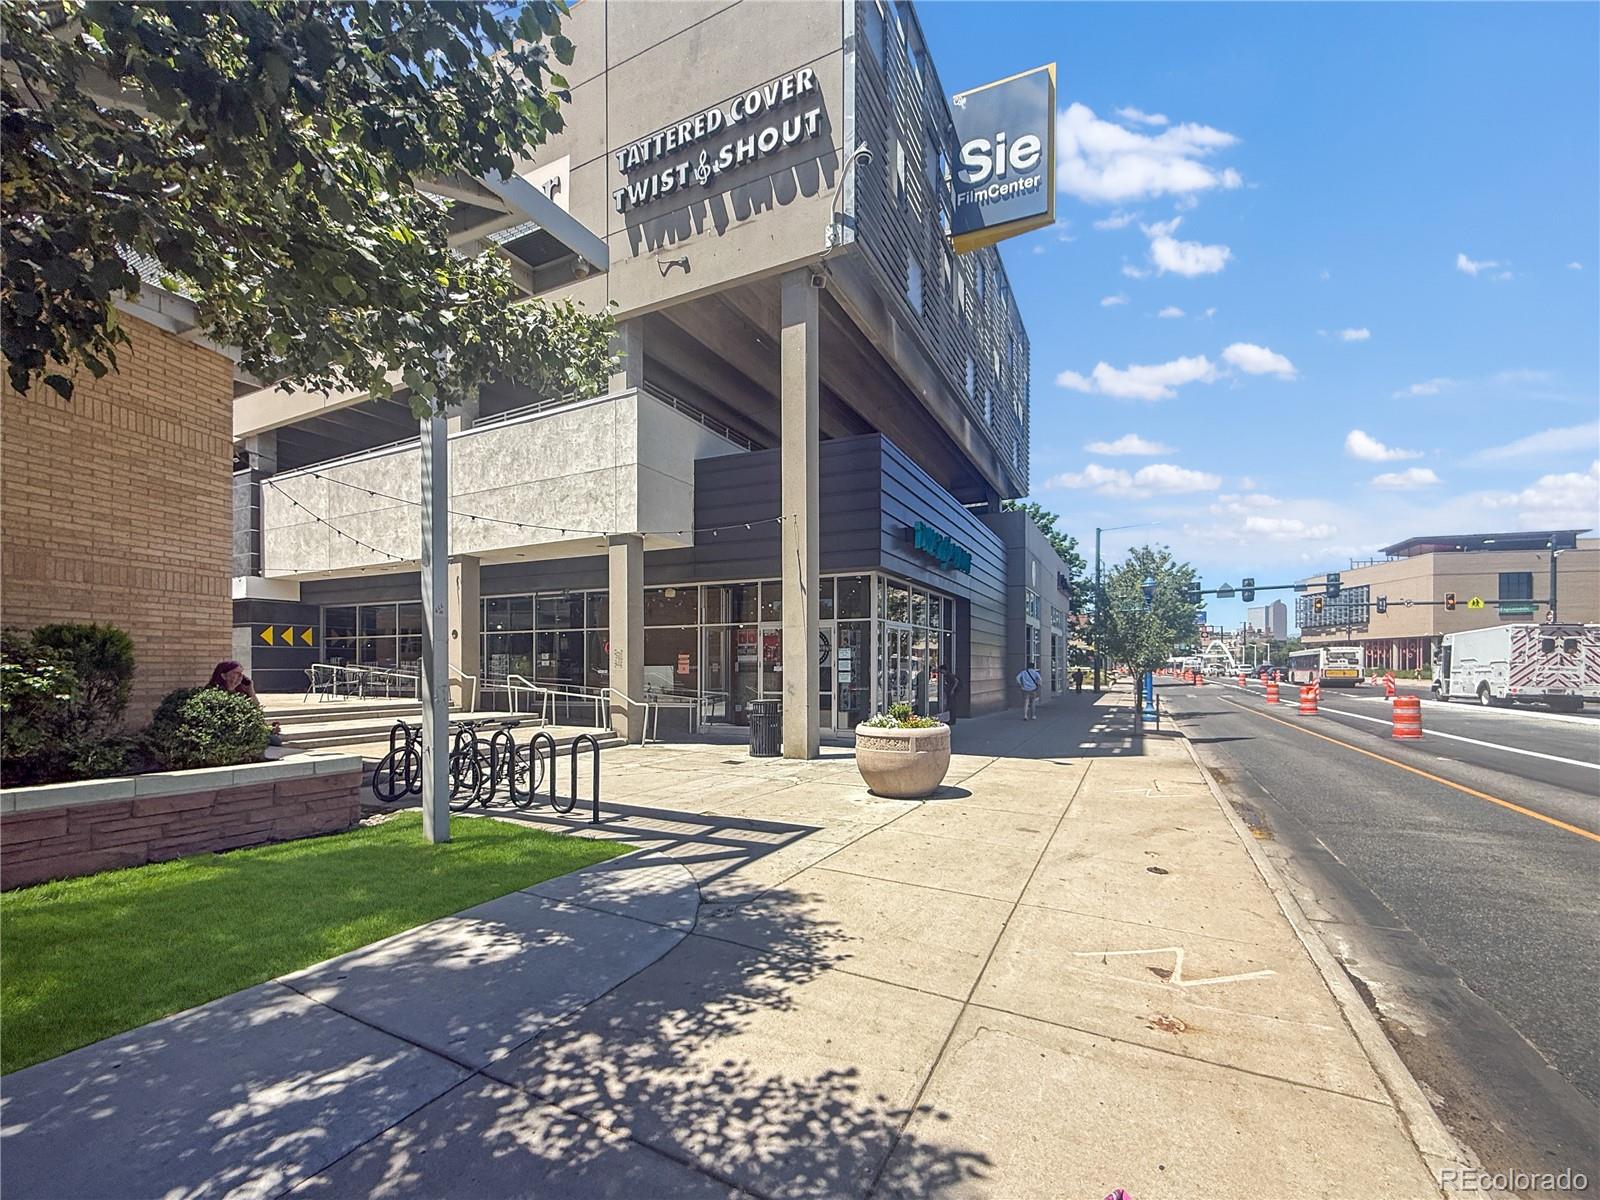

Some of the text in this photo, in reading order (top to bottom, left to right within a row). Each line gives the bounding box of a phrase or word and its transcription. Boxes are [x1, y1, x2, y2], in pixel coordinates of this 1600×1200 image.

[616, 67, 814, 172] TATTERED COVER
[957, 131, 1041, 184] Sie
[613, 161, 690, 212] TWIST
[718, 107, 821, 169] SHOUT
[956, 174, 1041, 207] FilmCenter
